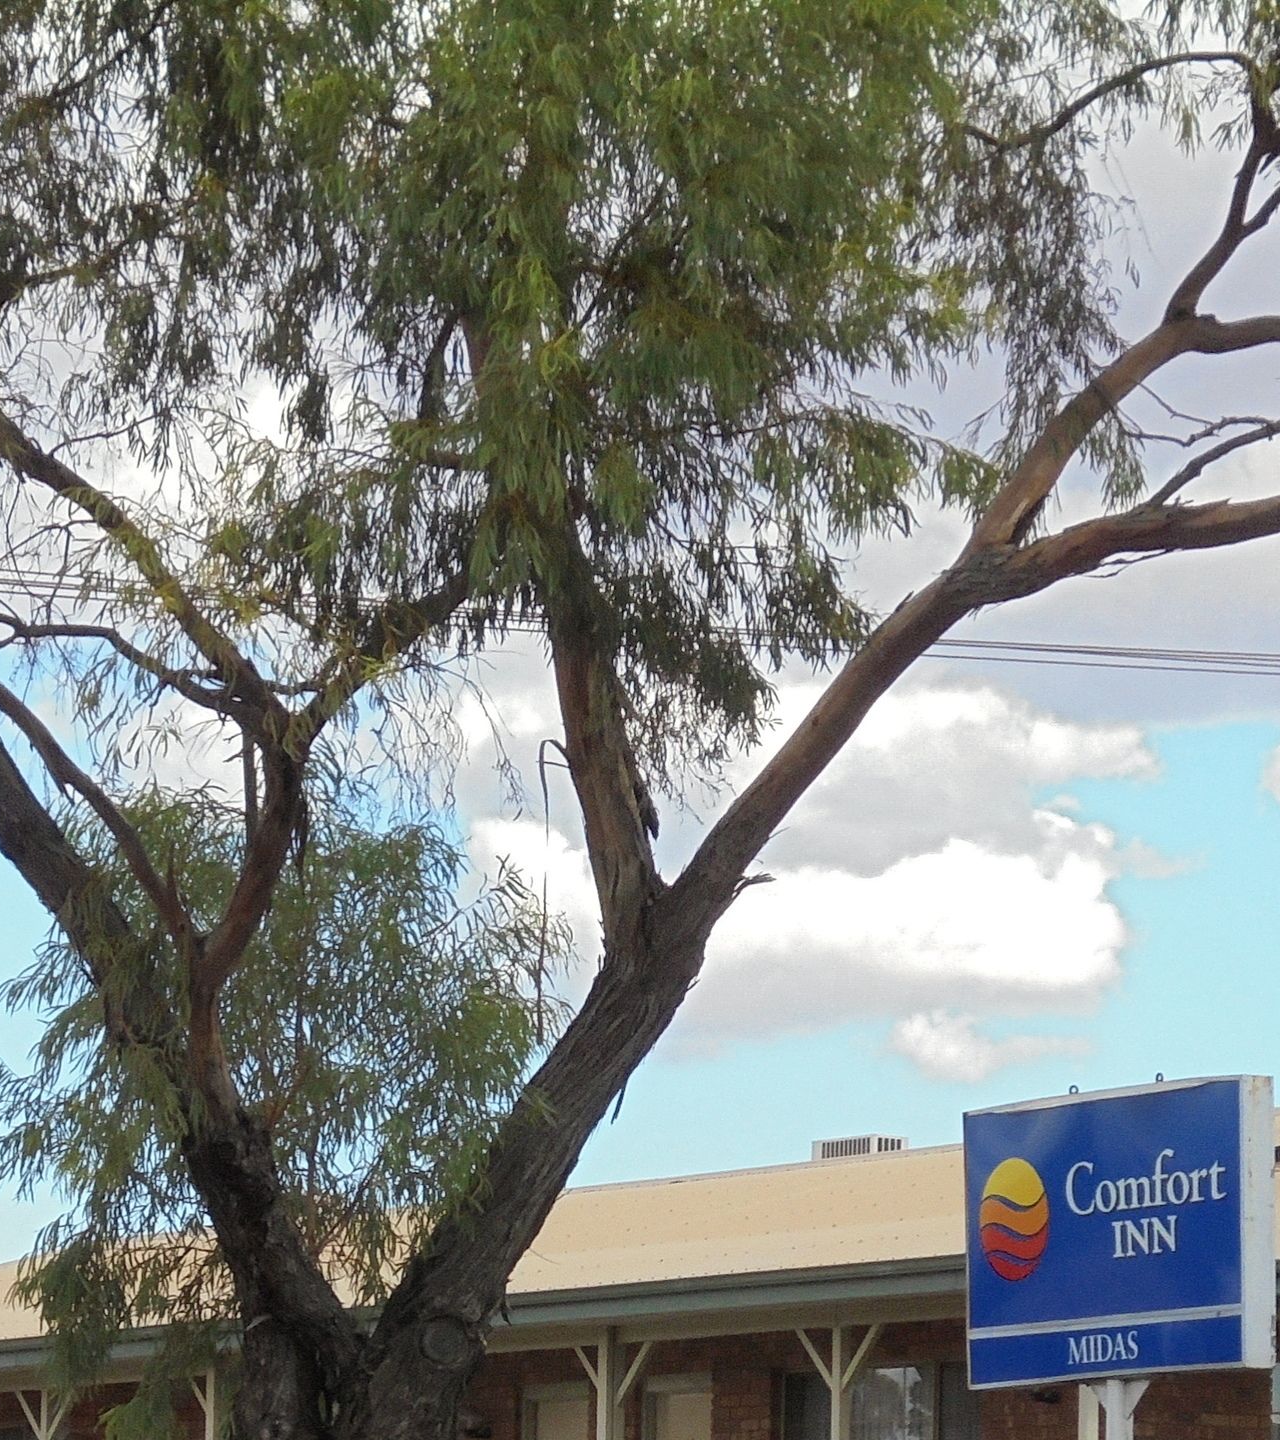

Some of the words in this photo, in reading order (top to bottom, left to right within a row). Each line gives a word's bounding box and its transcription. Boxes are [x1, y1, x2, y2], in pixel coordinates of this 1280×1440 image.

[1065, 1148, 1228, 1216] Comfort
[1112, 1215, 1177, 1259] INN
[1067, 1331, 1139, 1365] MIDAS
